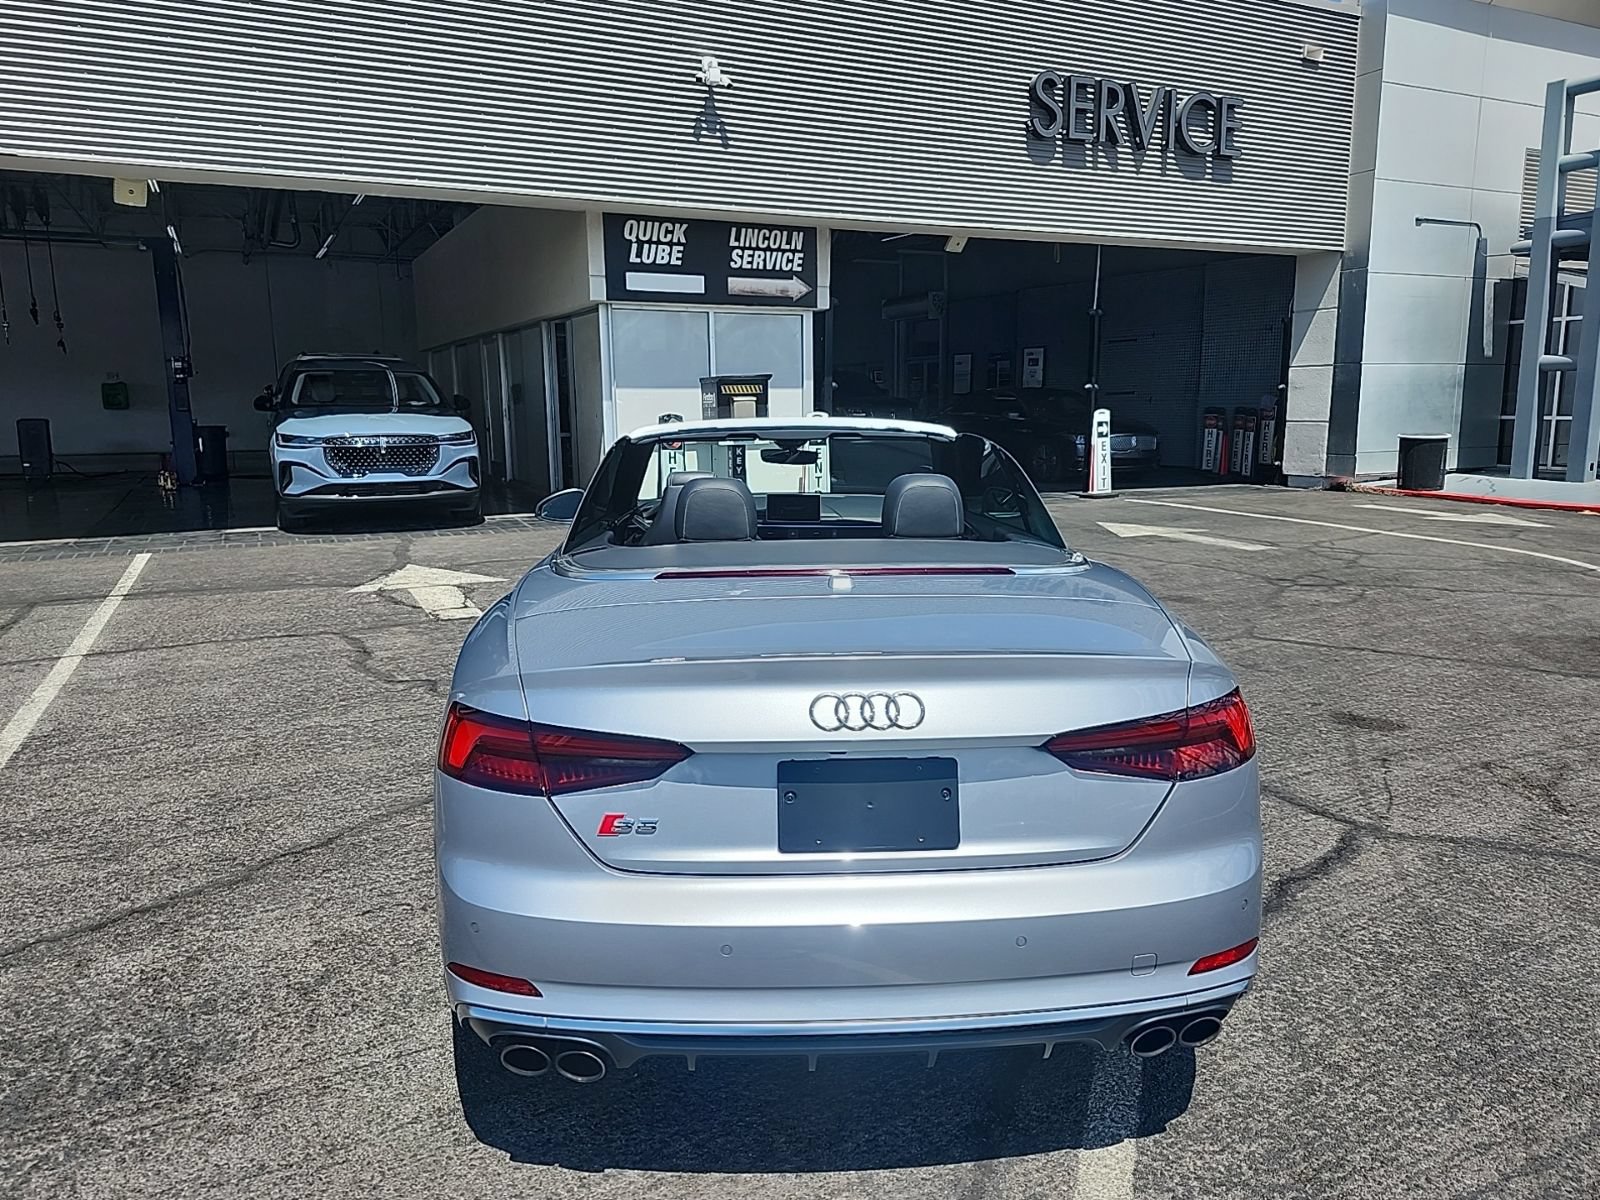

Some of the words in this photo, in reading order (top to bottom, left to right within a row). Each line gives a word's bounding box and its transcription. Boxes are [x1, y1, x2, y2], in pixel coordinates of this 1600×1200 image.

[1026, 70, 1244, 159] SERVICE
[624, 219, 689, 244] QUICK
[729, 227, 804, 250] LINCOLN
[629, 242, 684, 266] LUBE
[729, 249, 804, 272] SERVICE
[814, 447, 823, 493] ENT
[606, 816, 660, 836] S5
